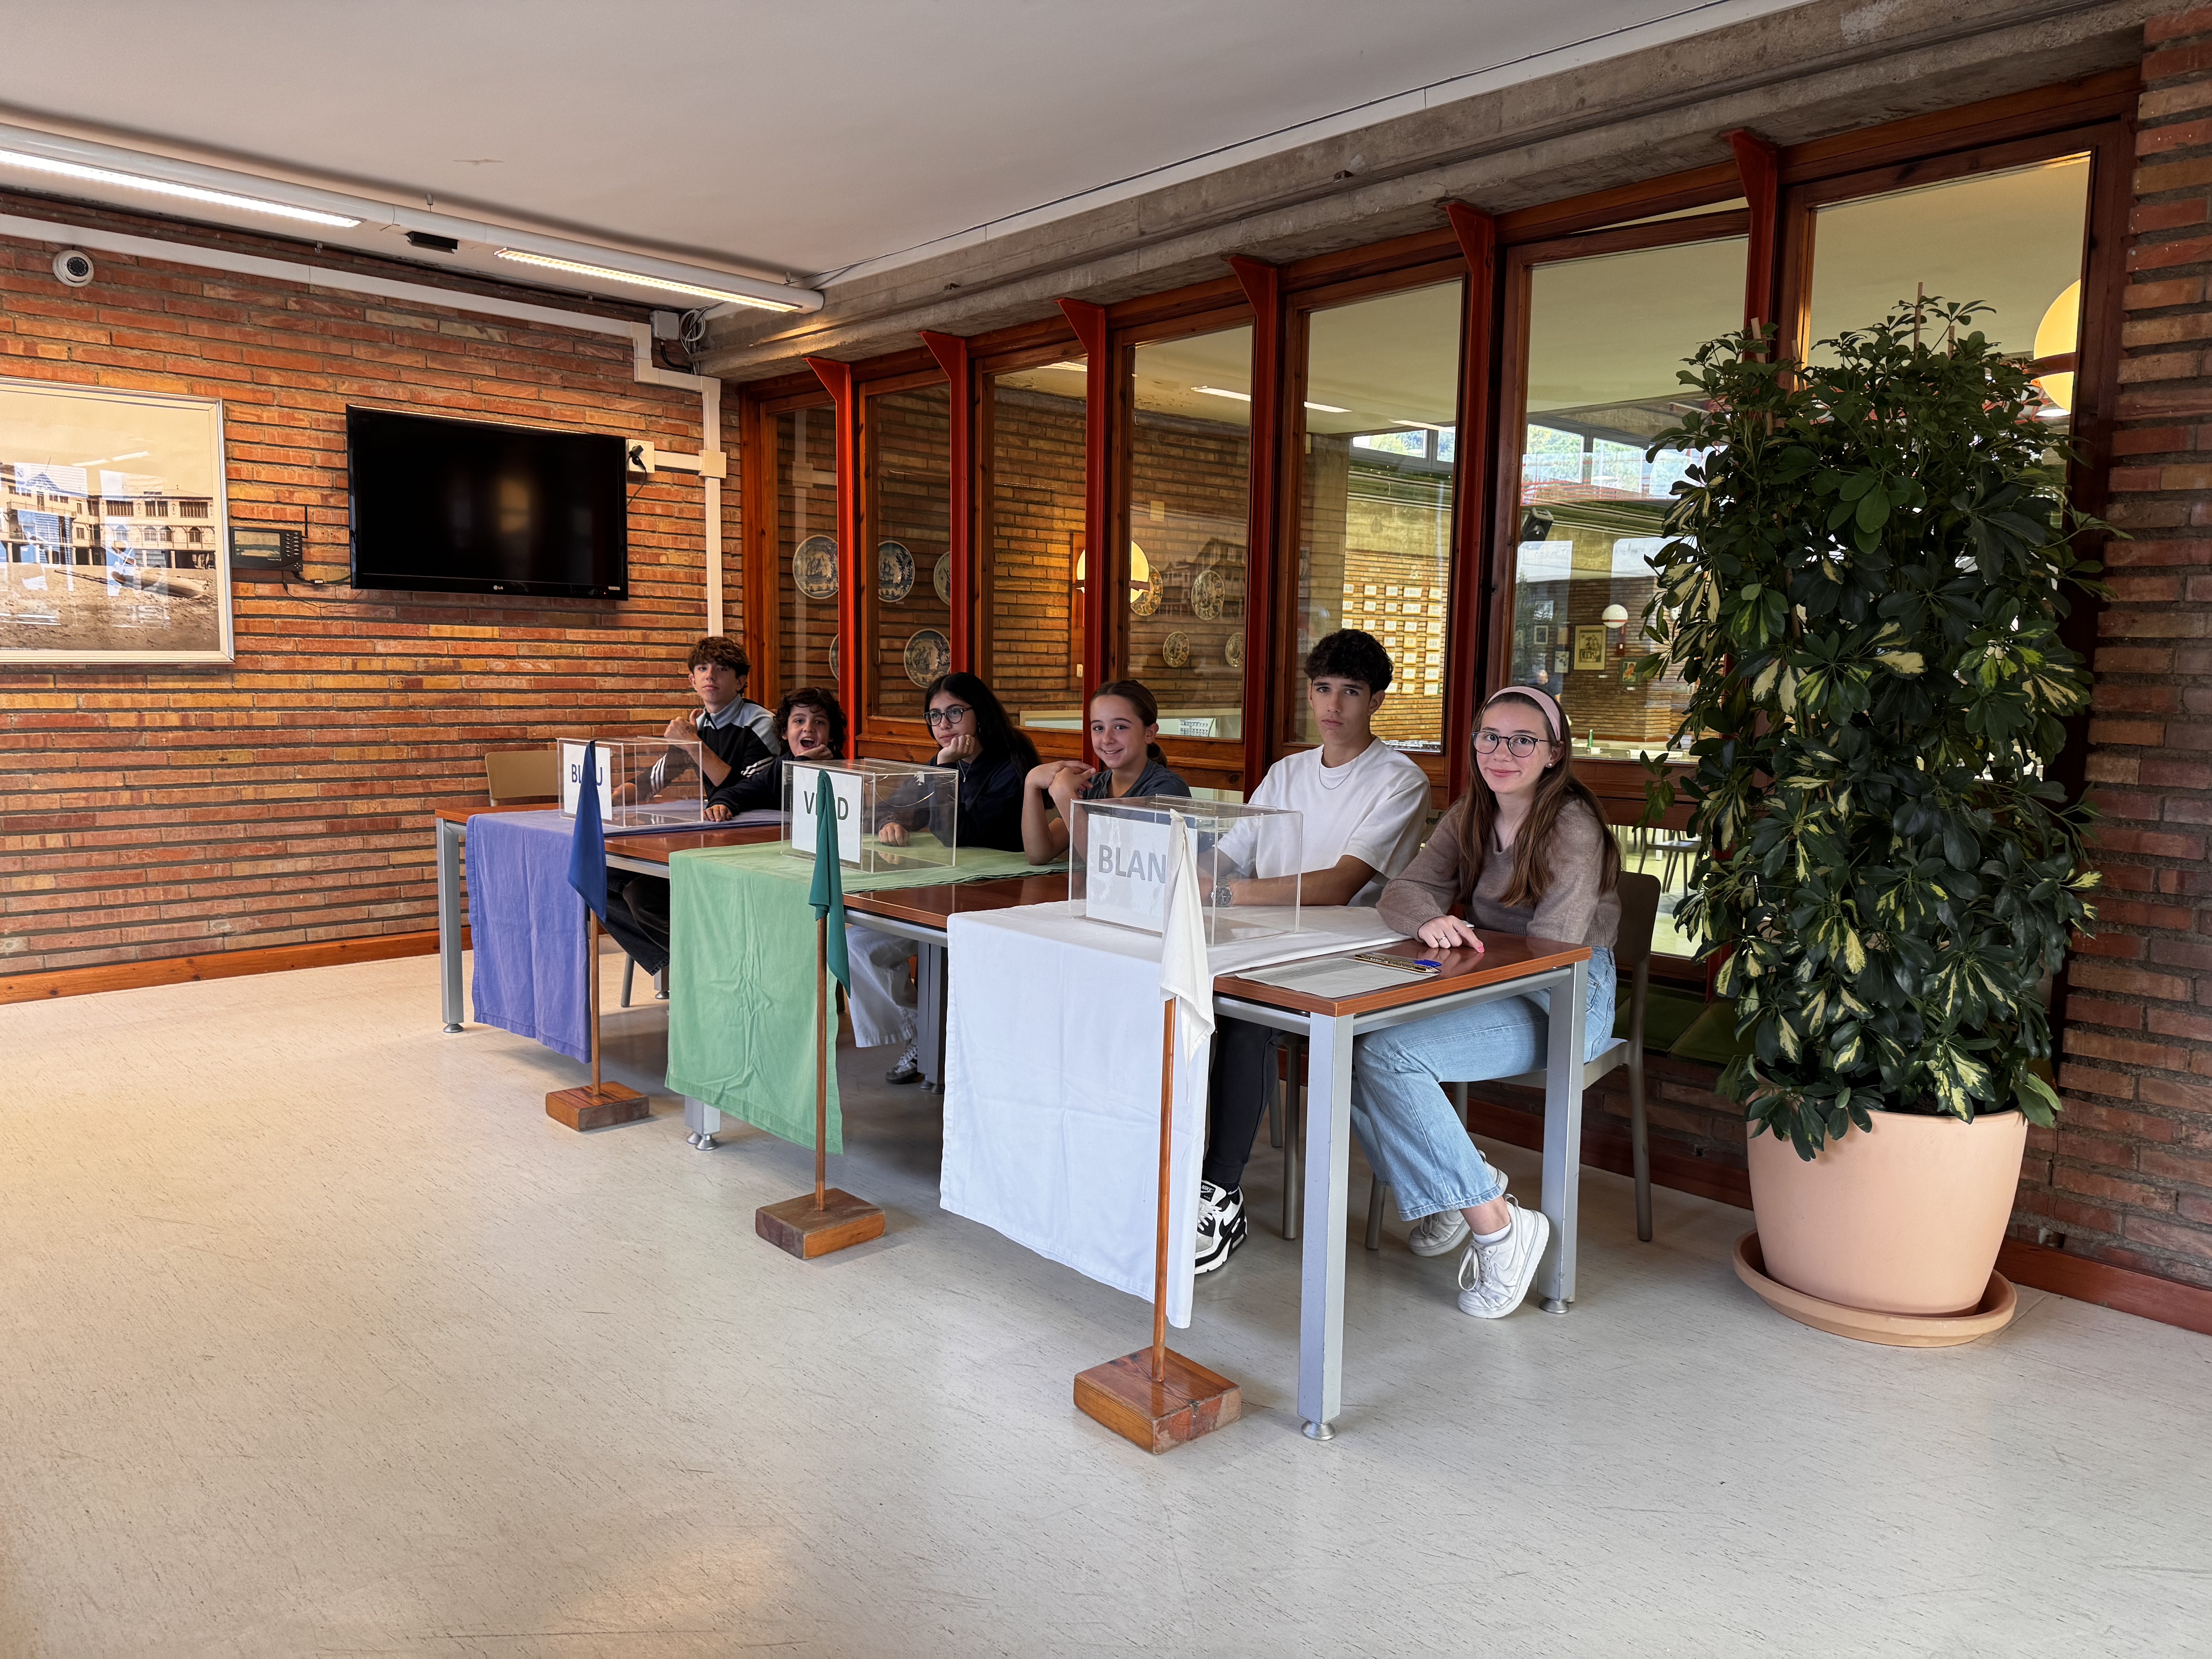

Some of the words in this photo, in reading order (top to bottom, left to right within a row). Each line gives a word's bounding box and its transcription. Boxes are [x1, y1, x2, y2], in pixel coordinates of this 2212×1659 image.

[572, 764, 603, 786] BLU
[804, 791, 848, 820] VD
[1099, 844, 1166, 883] BLAN
